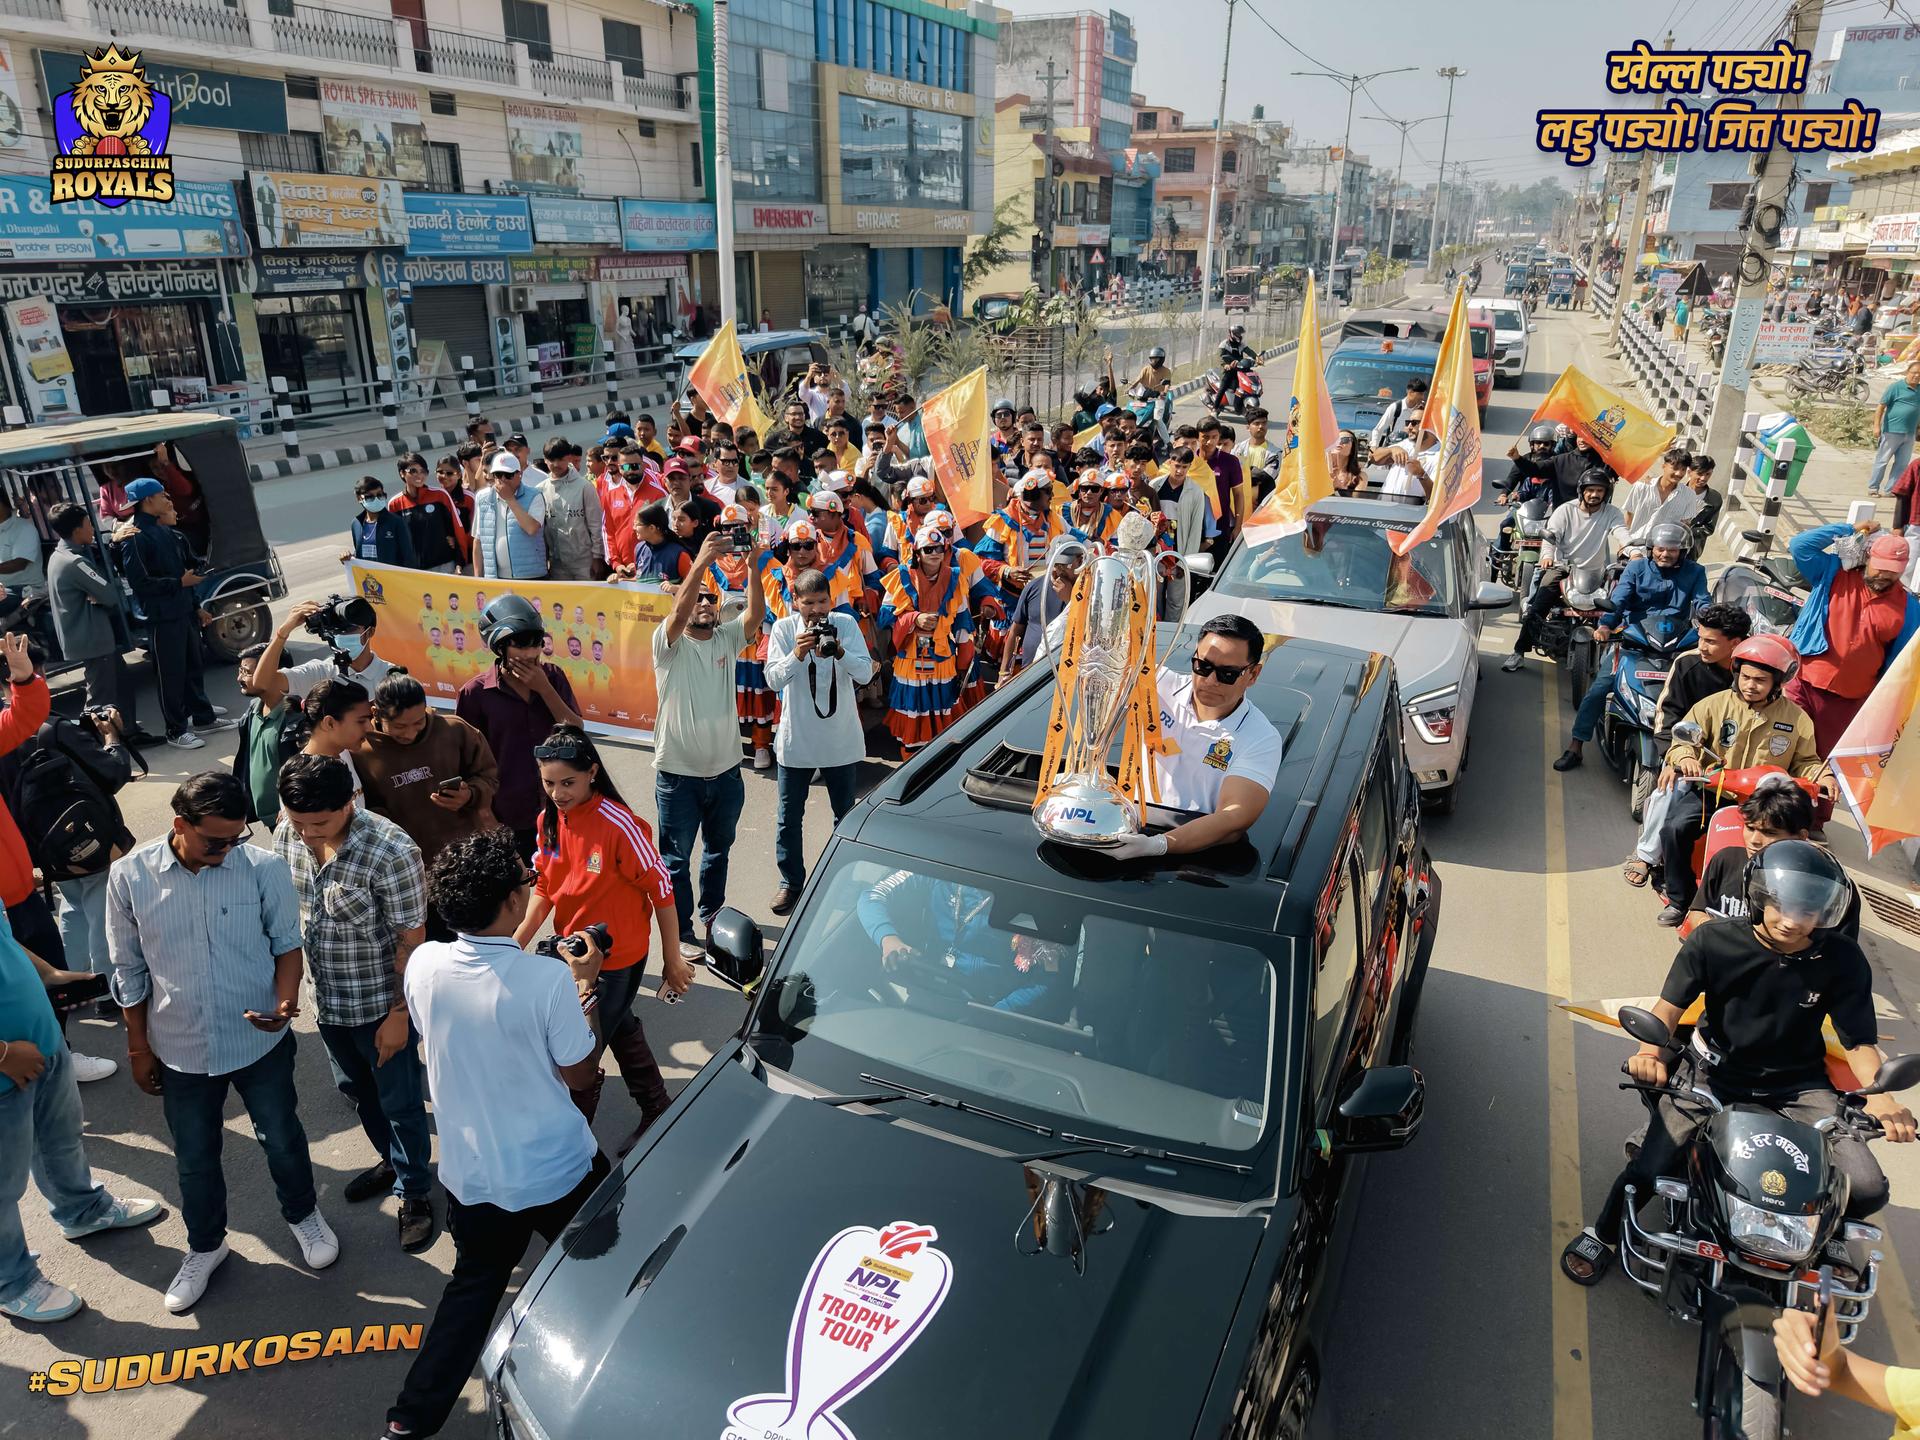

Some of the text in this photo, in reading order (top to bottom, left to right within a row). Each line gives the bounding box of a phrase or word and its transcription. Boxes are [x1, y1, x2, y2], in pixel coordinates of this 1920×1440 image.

[753, 207, 814, 229] EMERGENCY
[857, 211, 900, 229] ENTRANCE
[935, 215, 970, 231] PHARMACY
[7, 224, 60, 236] Dhangadhi
[56, 244, 93, 254] EPSON
[1335, 360, 1434, 374] NEPAL POLICE
[1328, 515, 1371, 526] Tripura
[1060, 807, 1096, 824] NPL
[1751, 1132, 1773, 1148] हर
[1775, 1134, 1810, 1175] महादेव
[1762, 1196, 1785, 1207] Hero
[846, 1266, 901, 1299] NPL
[818, 1293, 900, 1335] TROPHY
[819, 1316, 875, 1353] TOUR
